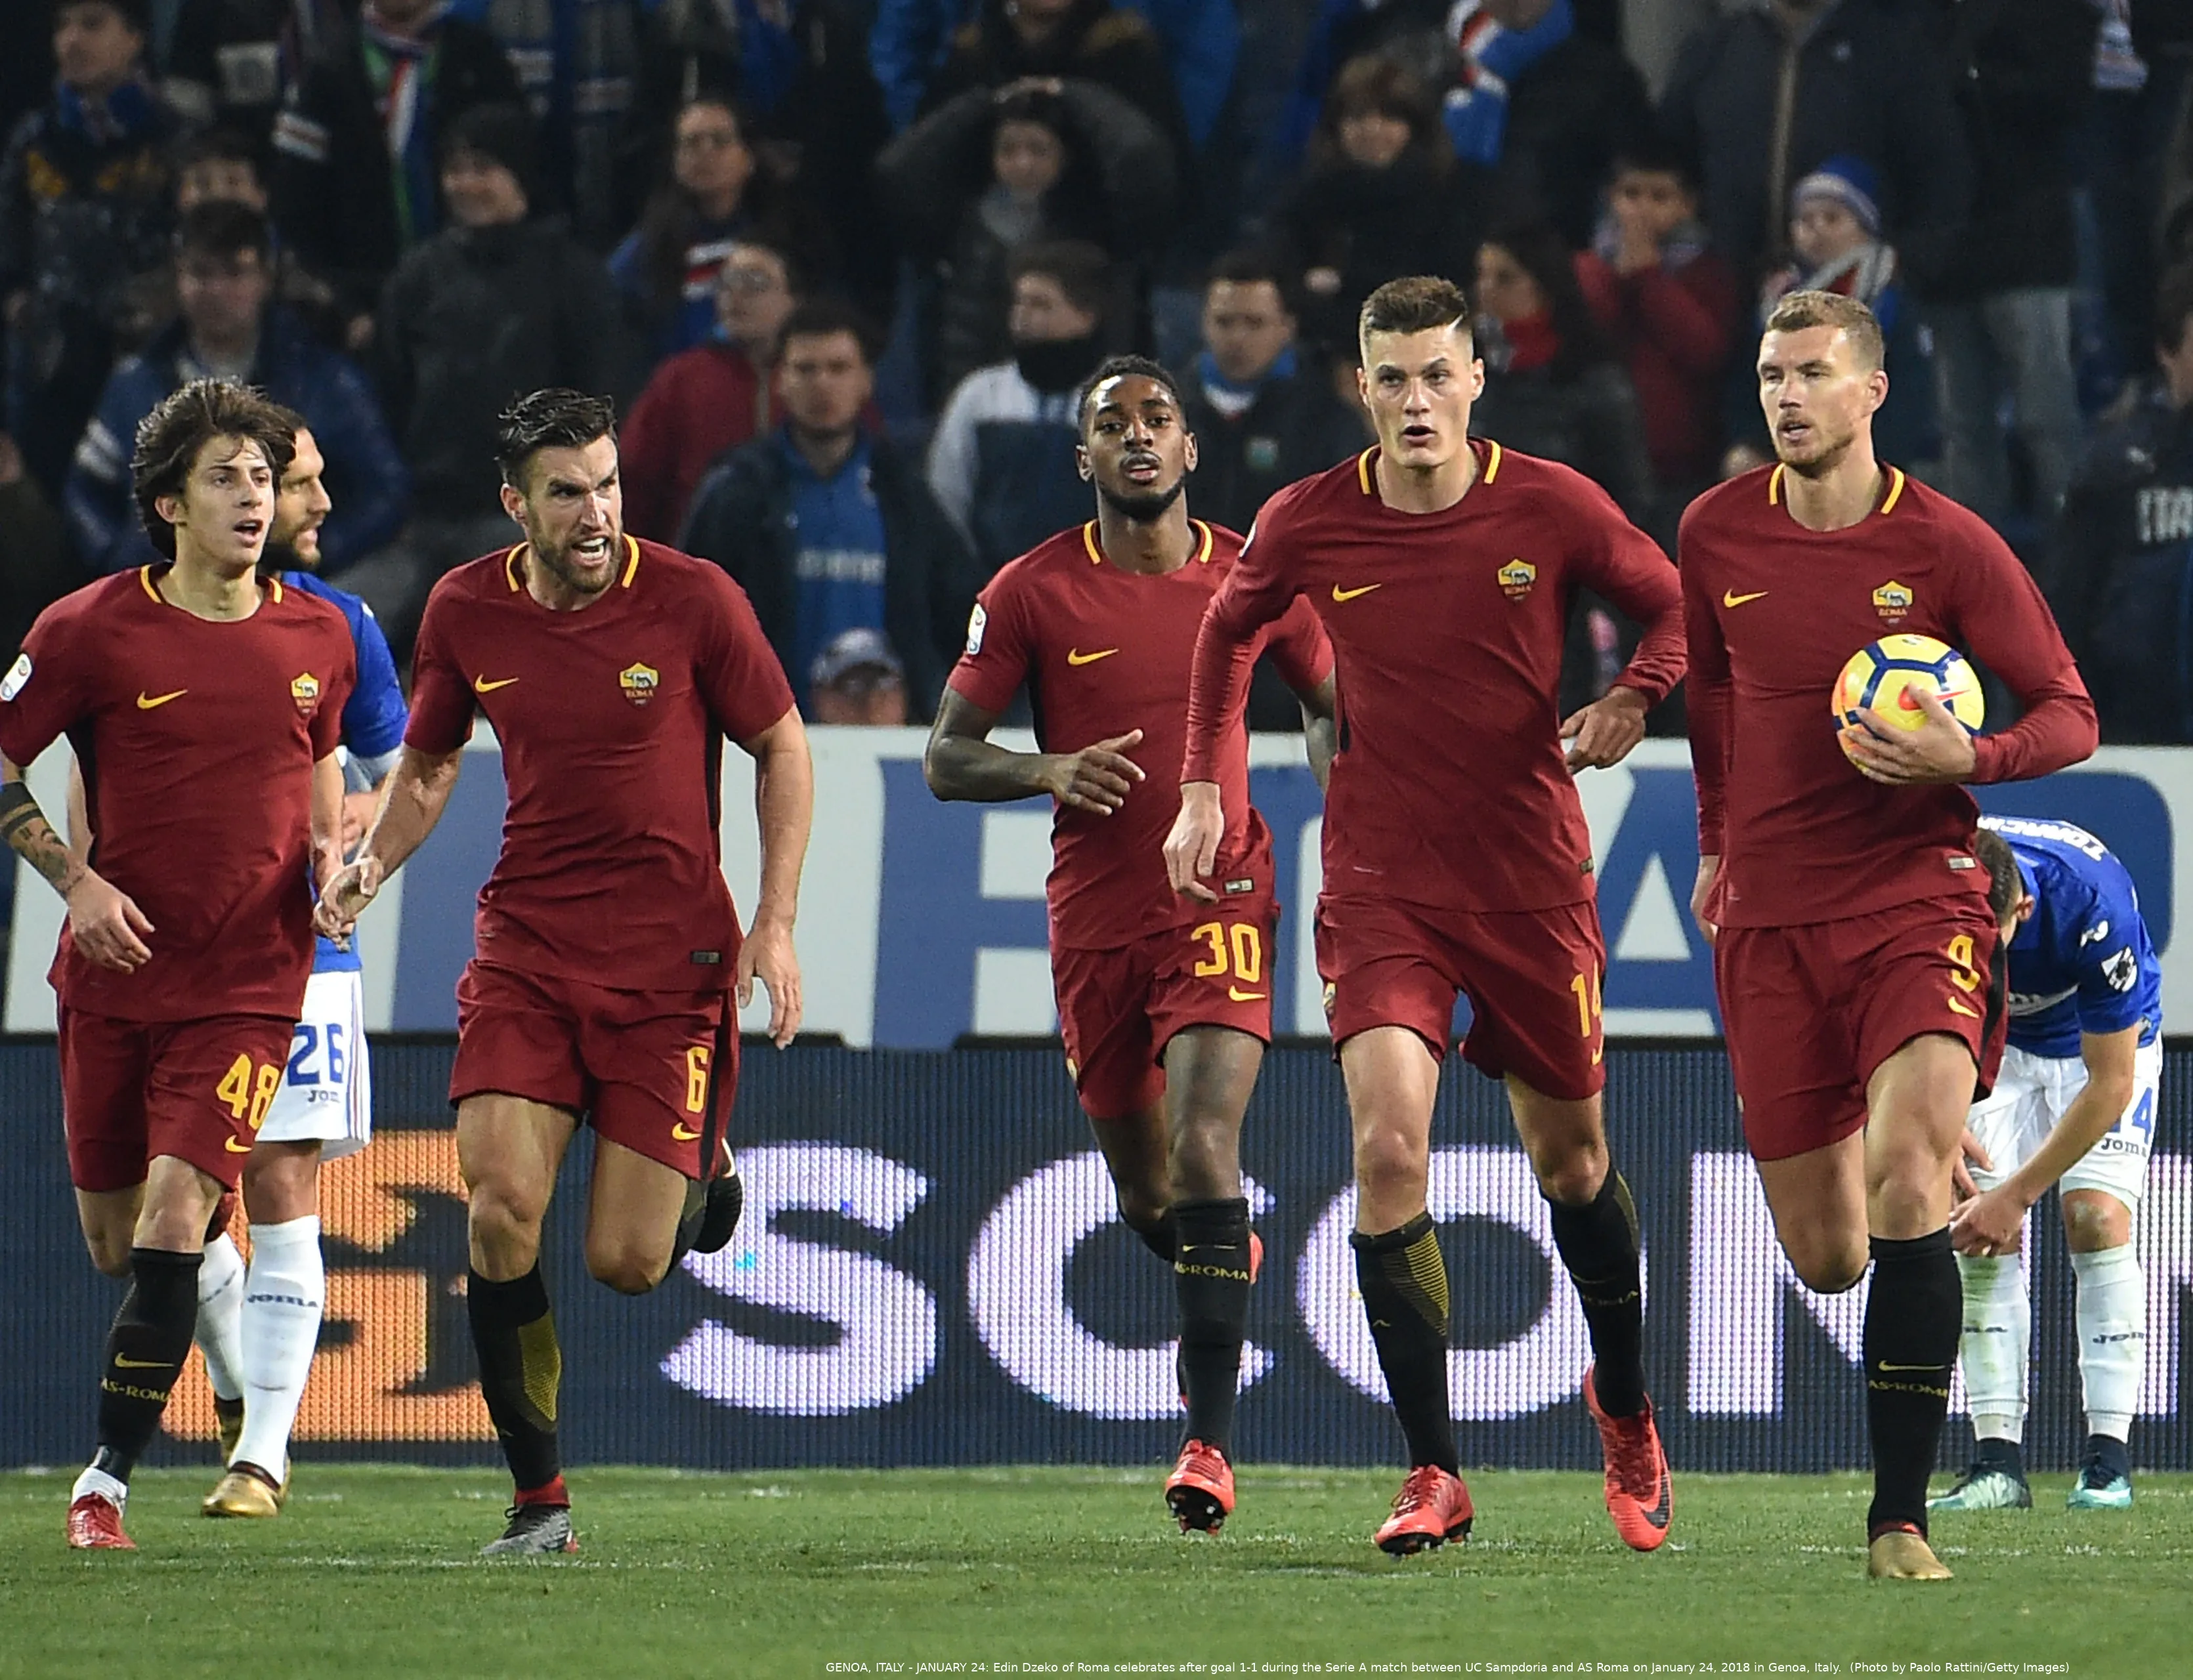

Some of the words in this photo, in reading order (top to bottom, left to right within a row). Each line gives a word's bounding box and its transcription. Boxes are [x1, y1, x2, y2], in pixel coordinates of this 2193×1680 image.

[1191, 921, 1262, 983] 30
[1948, 934, 1981, 993] 9
[215, 1053, 280, 1130] 48
[686, 1046, 710, 1114] 6
